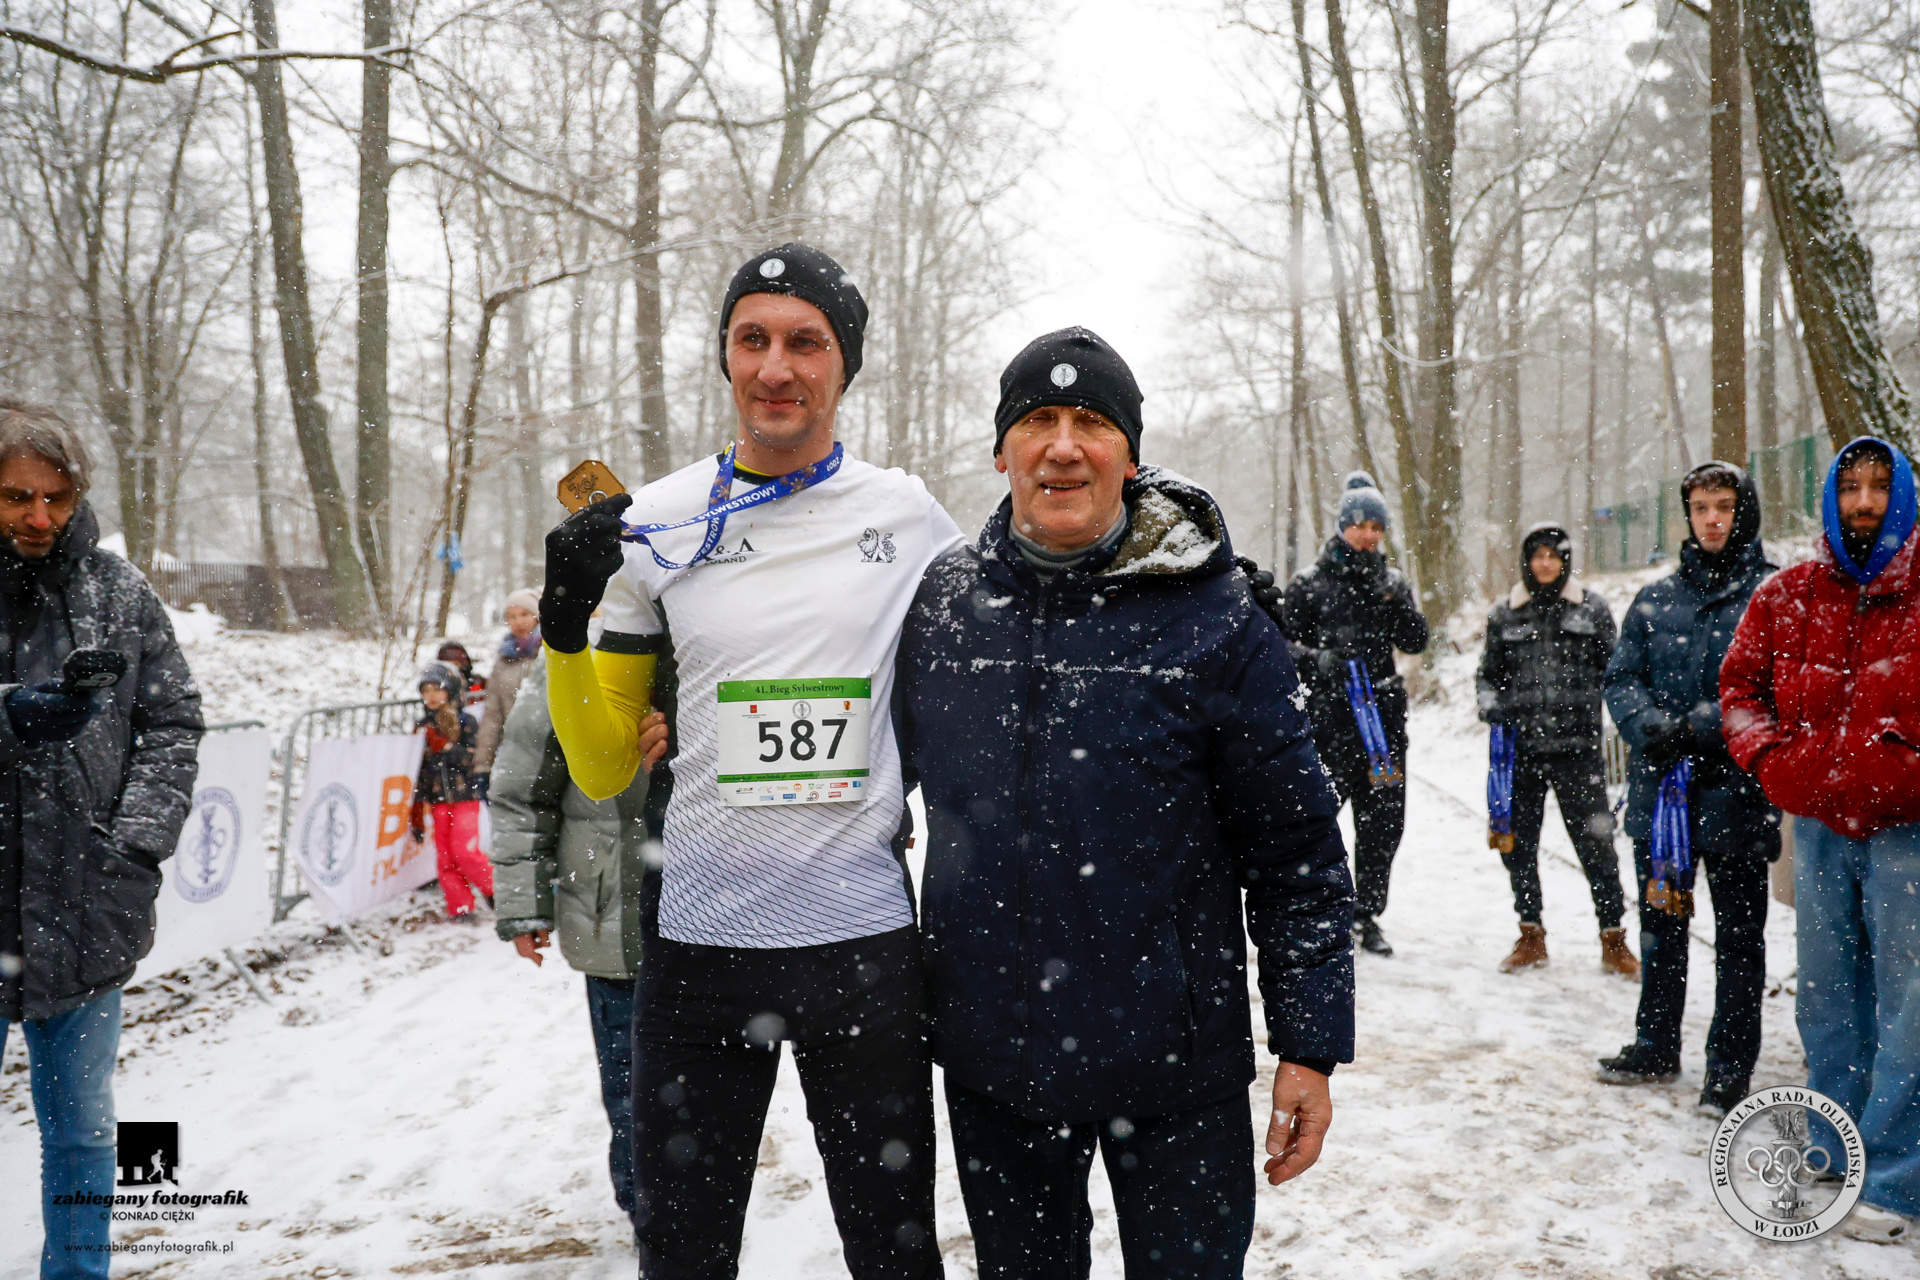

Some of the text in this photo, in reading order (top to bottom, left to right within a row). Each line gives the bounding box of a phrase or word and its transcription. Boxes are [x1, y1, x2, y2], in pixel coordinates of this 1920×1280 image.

[755, 685, 768, 694] 41.
[770, 685, 789, 696] Bieg
[758, 718, 848, 763] 587
